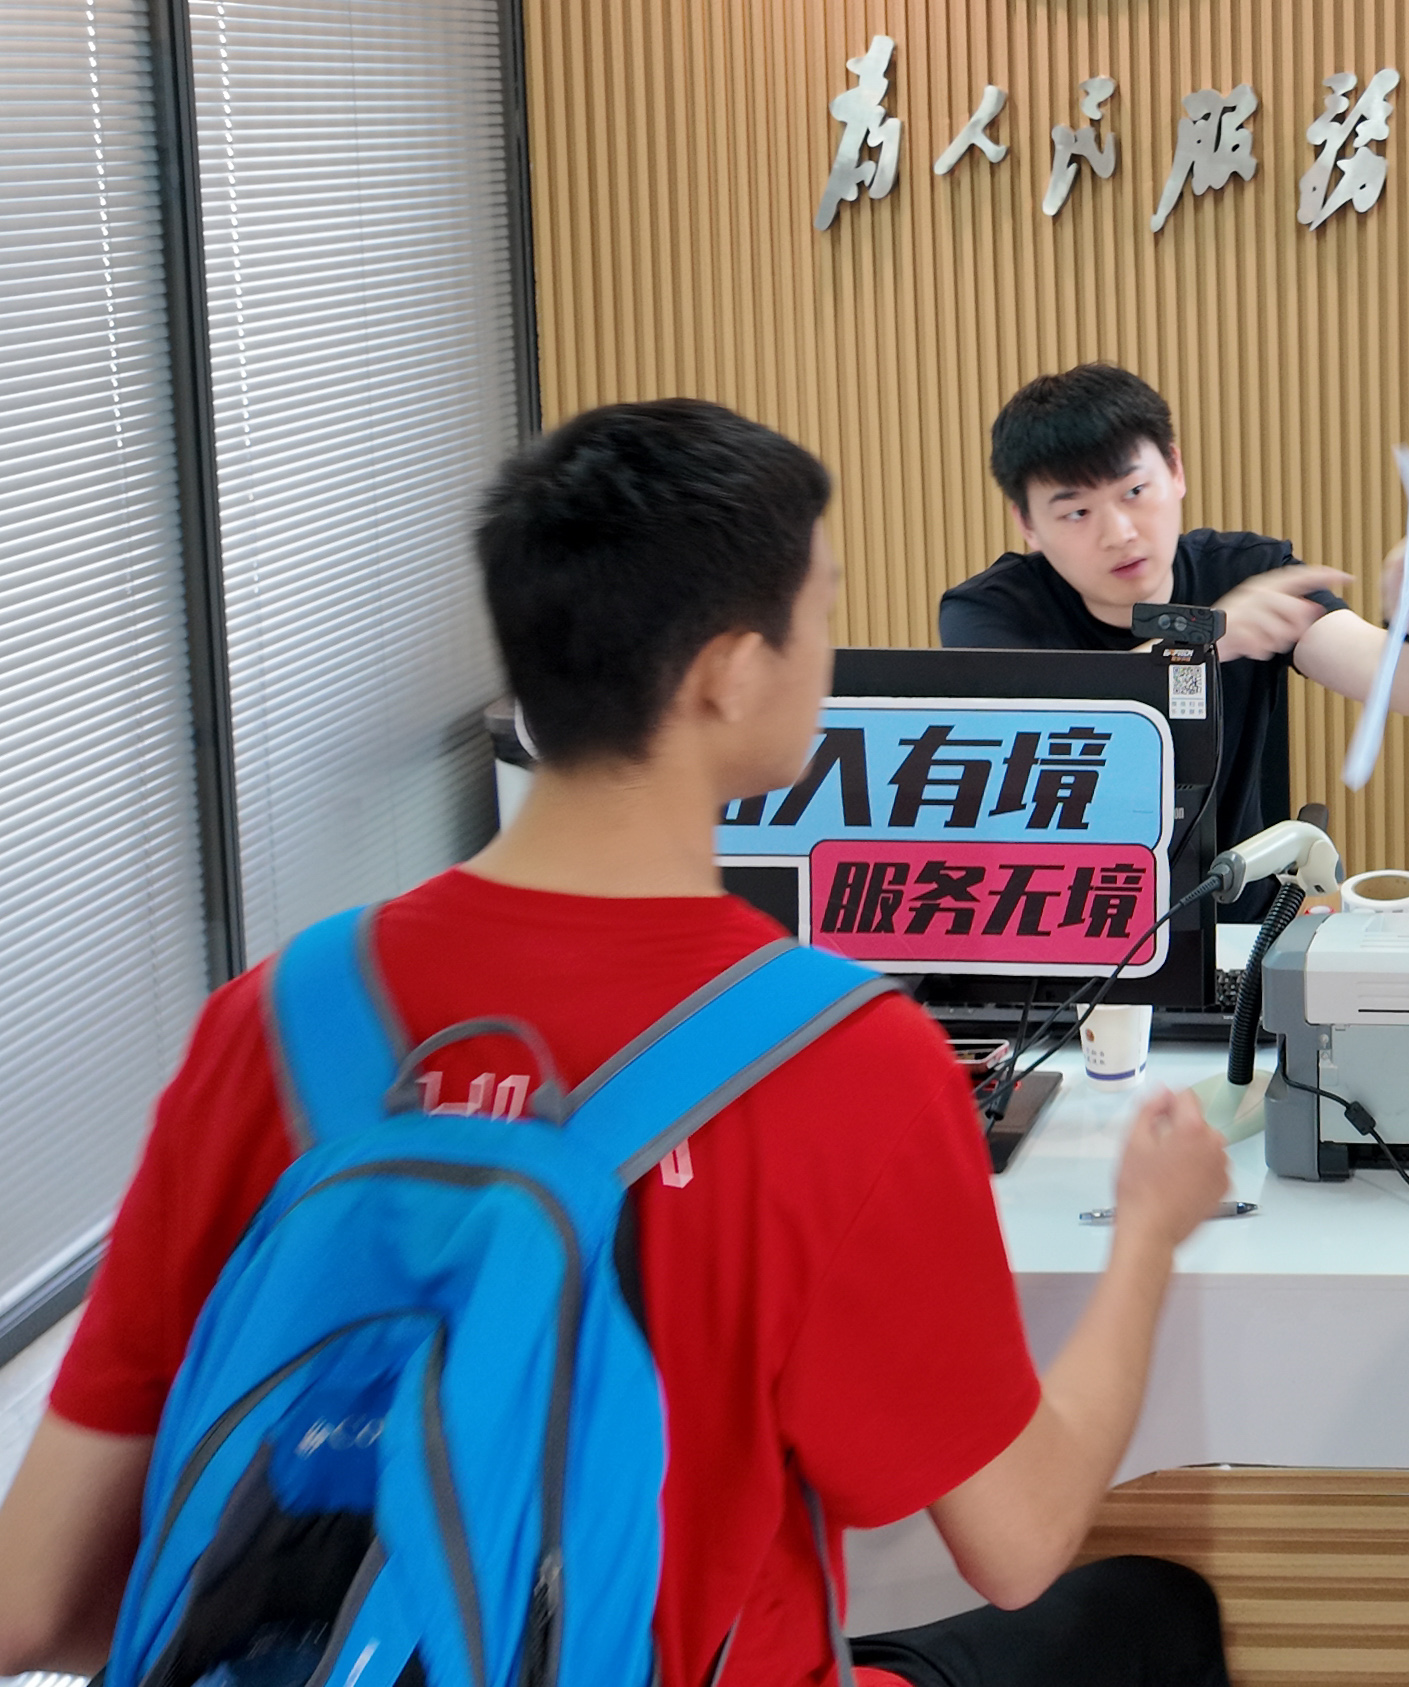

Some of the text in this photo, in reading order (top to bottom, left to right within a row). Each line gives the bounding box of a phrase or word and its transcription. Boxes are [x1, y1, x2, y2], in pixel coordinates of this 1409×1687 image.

[718, 725, 1112, 830] 入有境
[820, 860, 1147, 939] 服务无境
